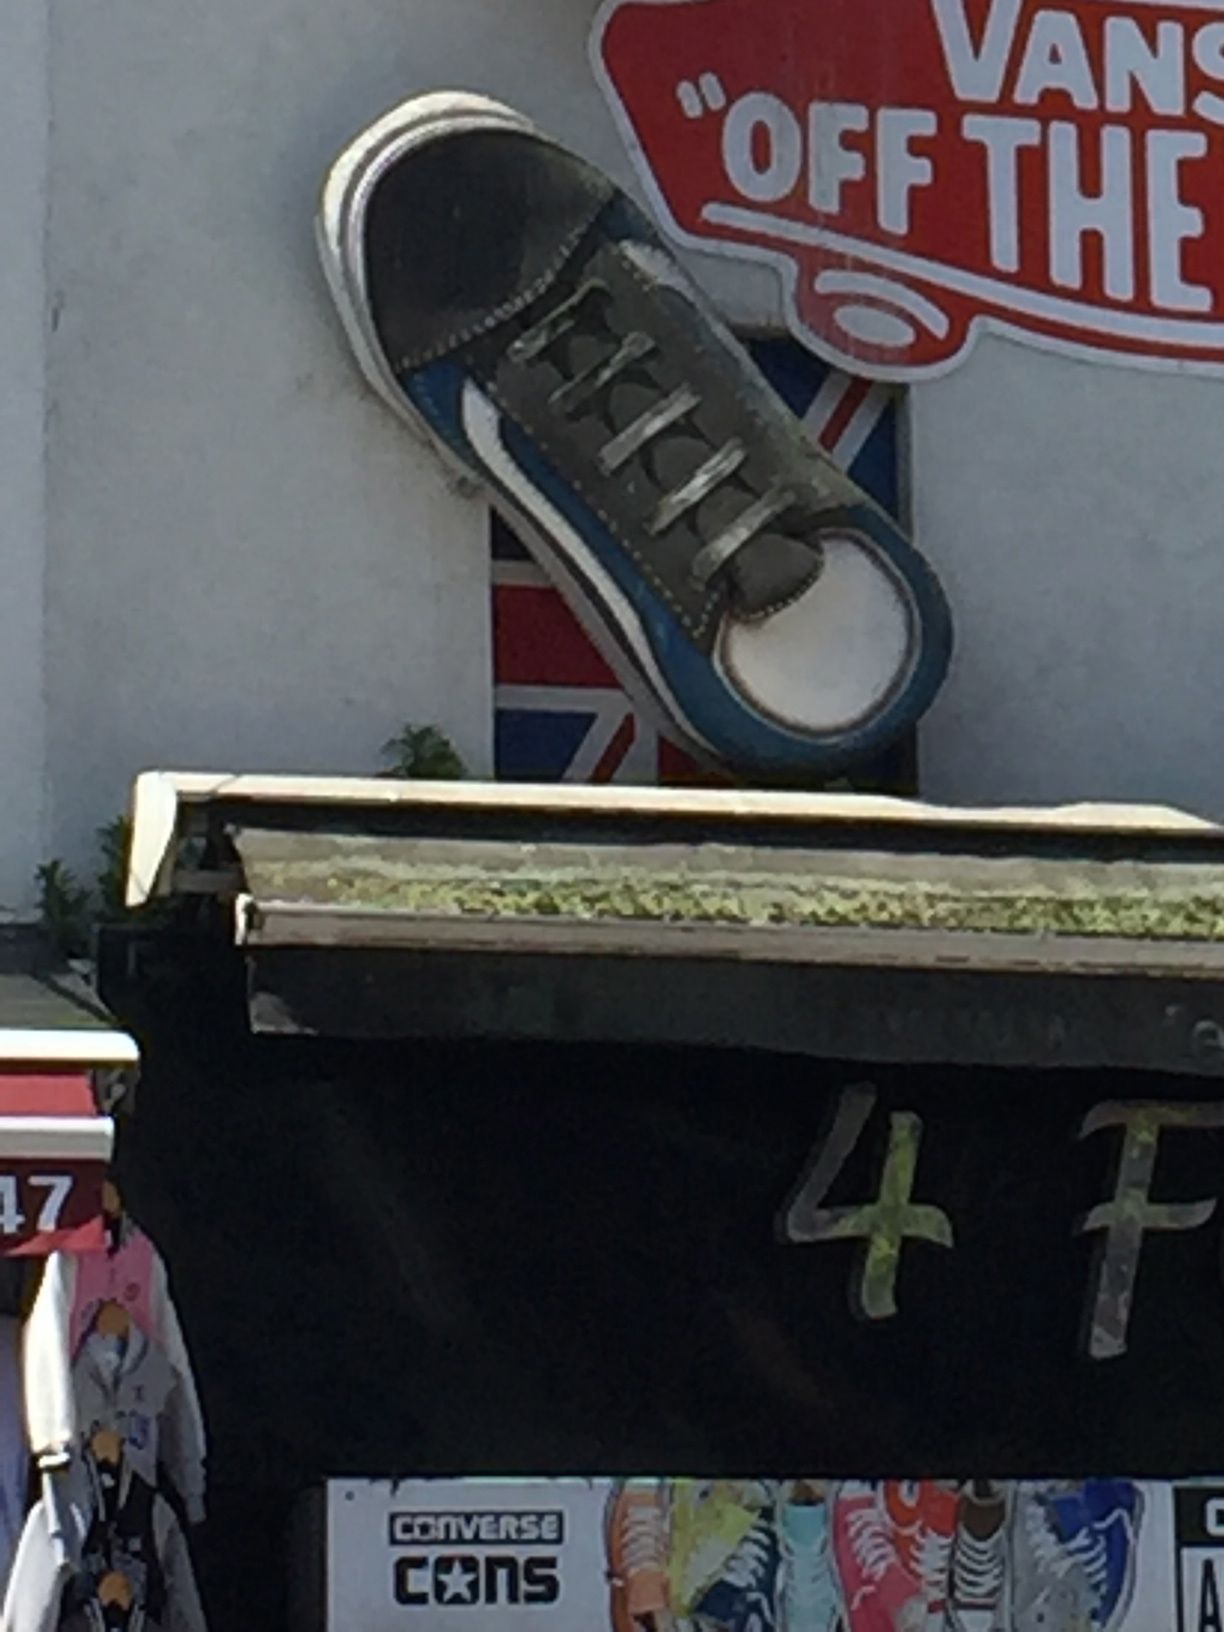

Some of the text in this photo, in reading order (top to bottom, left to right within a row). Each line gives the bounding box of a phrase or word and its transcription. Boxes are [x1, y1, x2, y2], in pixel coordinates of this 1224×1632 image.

[961, 115, 1213, 312] THE
[785, 1081, 954, 1319] 4
[393, 1514, 560, 1541] CONVERSE
[393, 1555, 560, 1605] CONS
